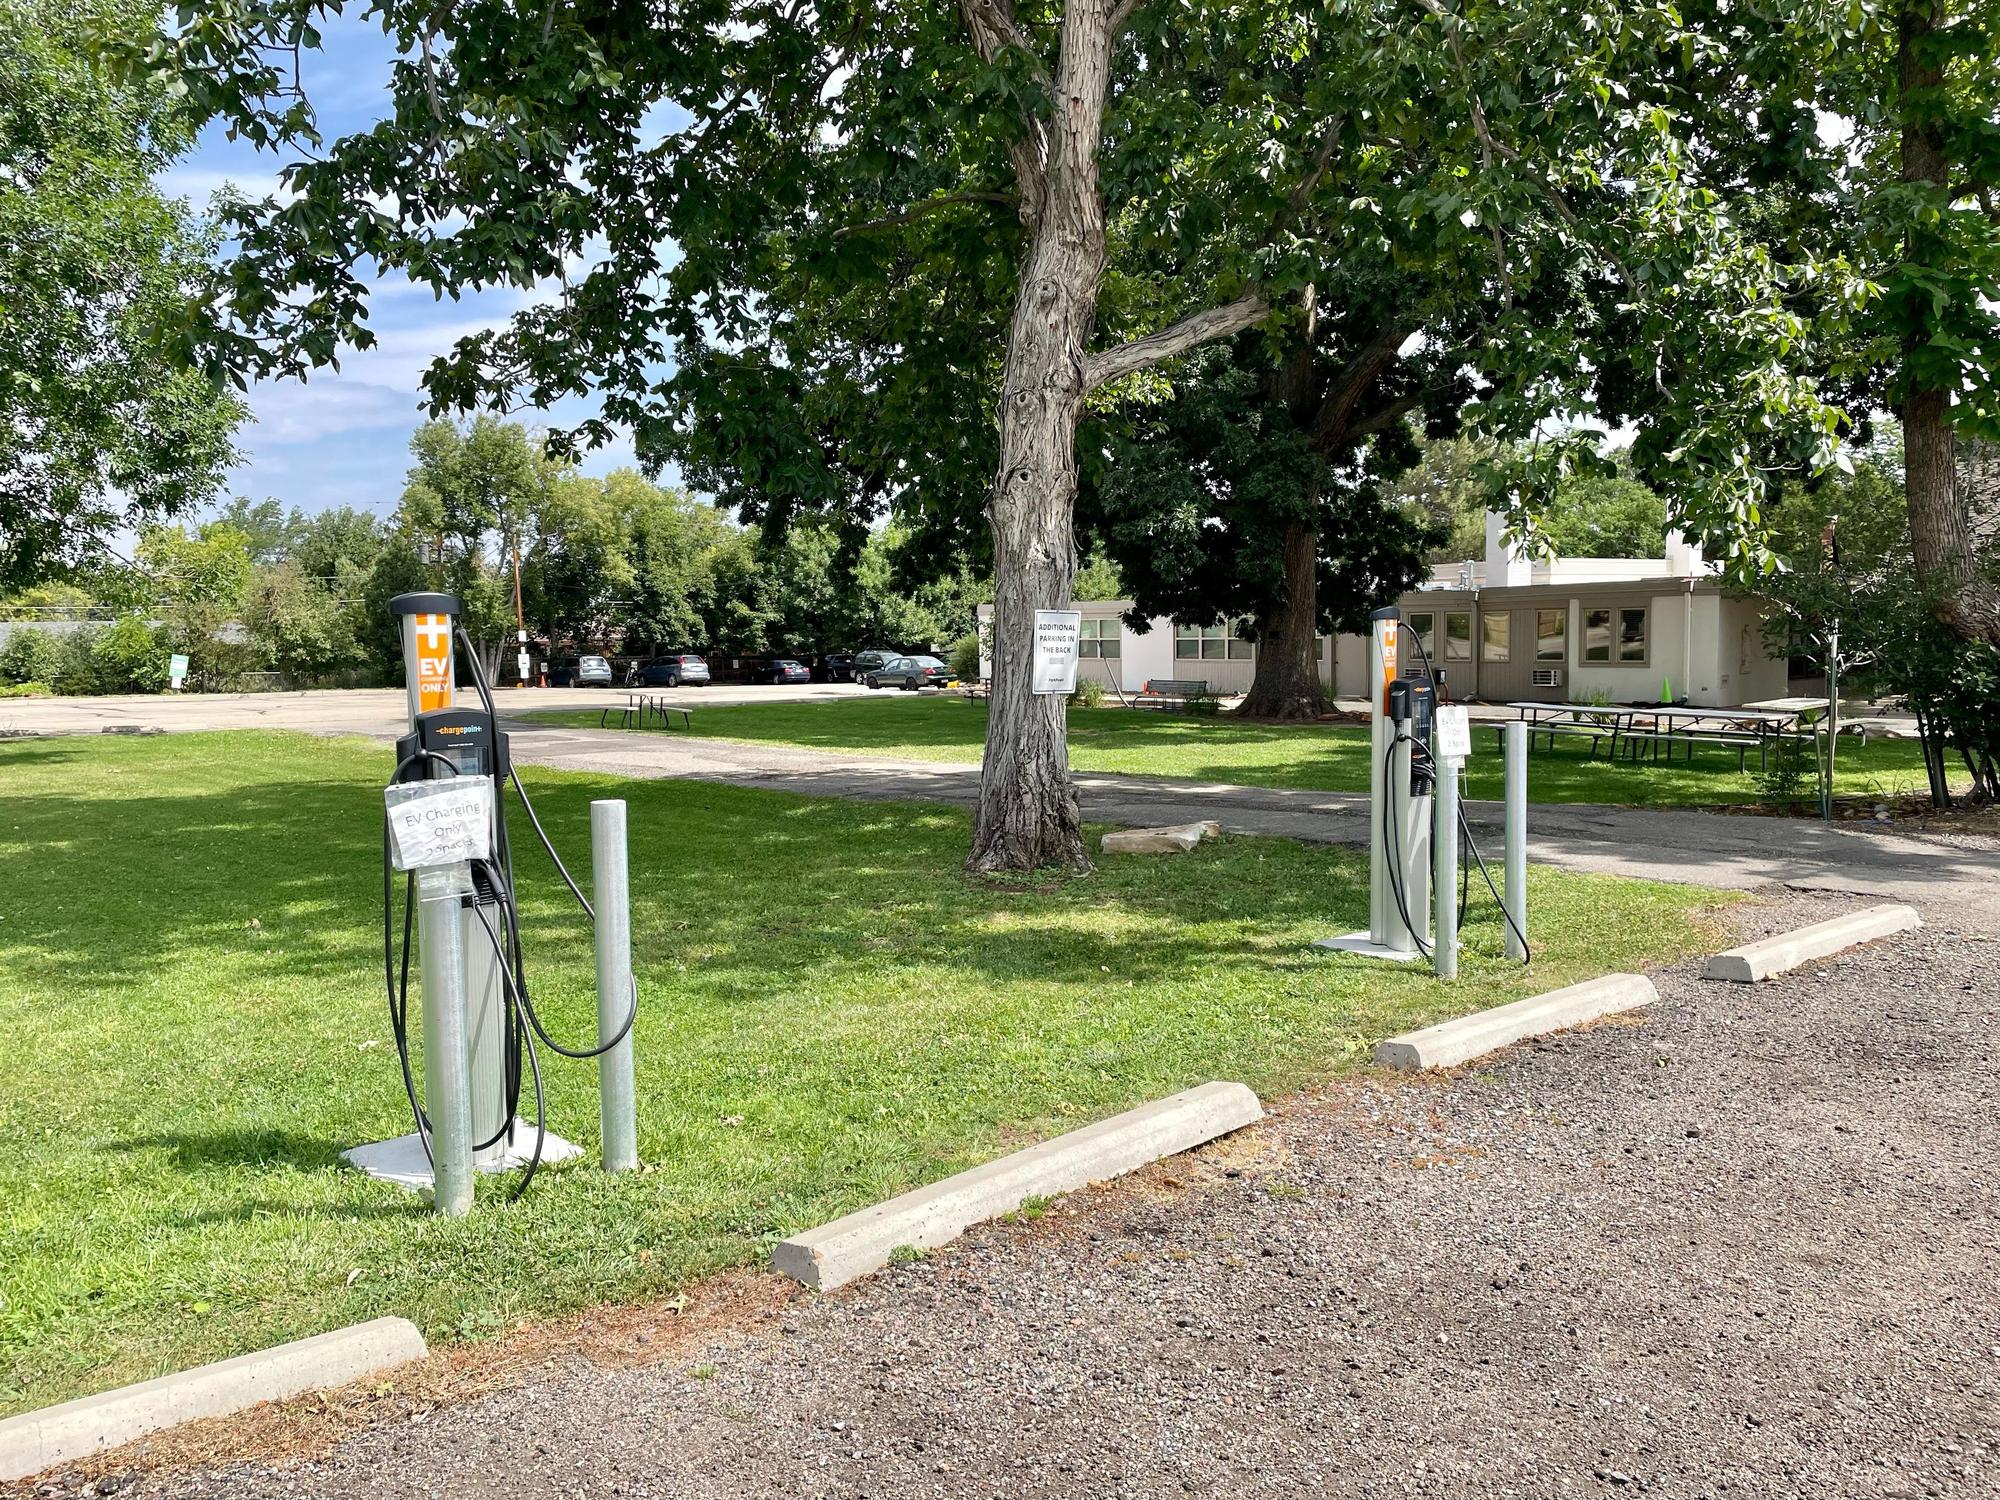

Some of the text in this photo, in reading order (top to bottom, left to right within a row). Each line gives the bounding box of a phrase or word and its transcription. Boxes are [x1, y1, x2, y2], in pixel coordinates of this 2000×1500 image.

[421, 658, 448, 675] EV
[421, 683, 448, 692] ONLY
[405, 802, 480, 828] EV Charging
[434, 823, 461, 837] Only
